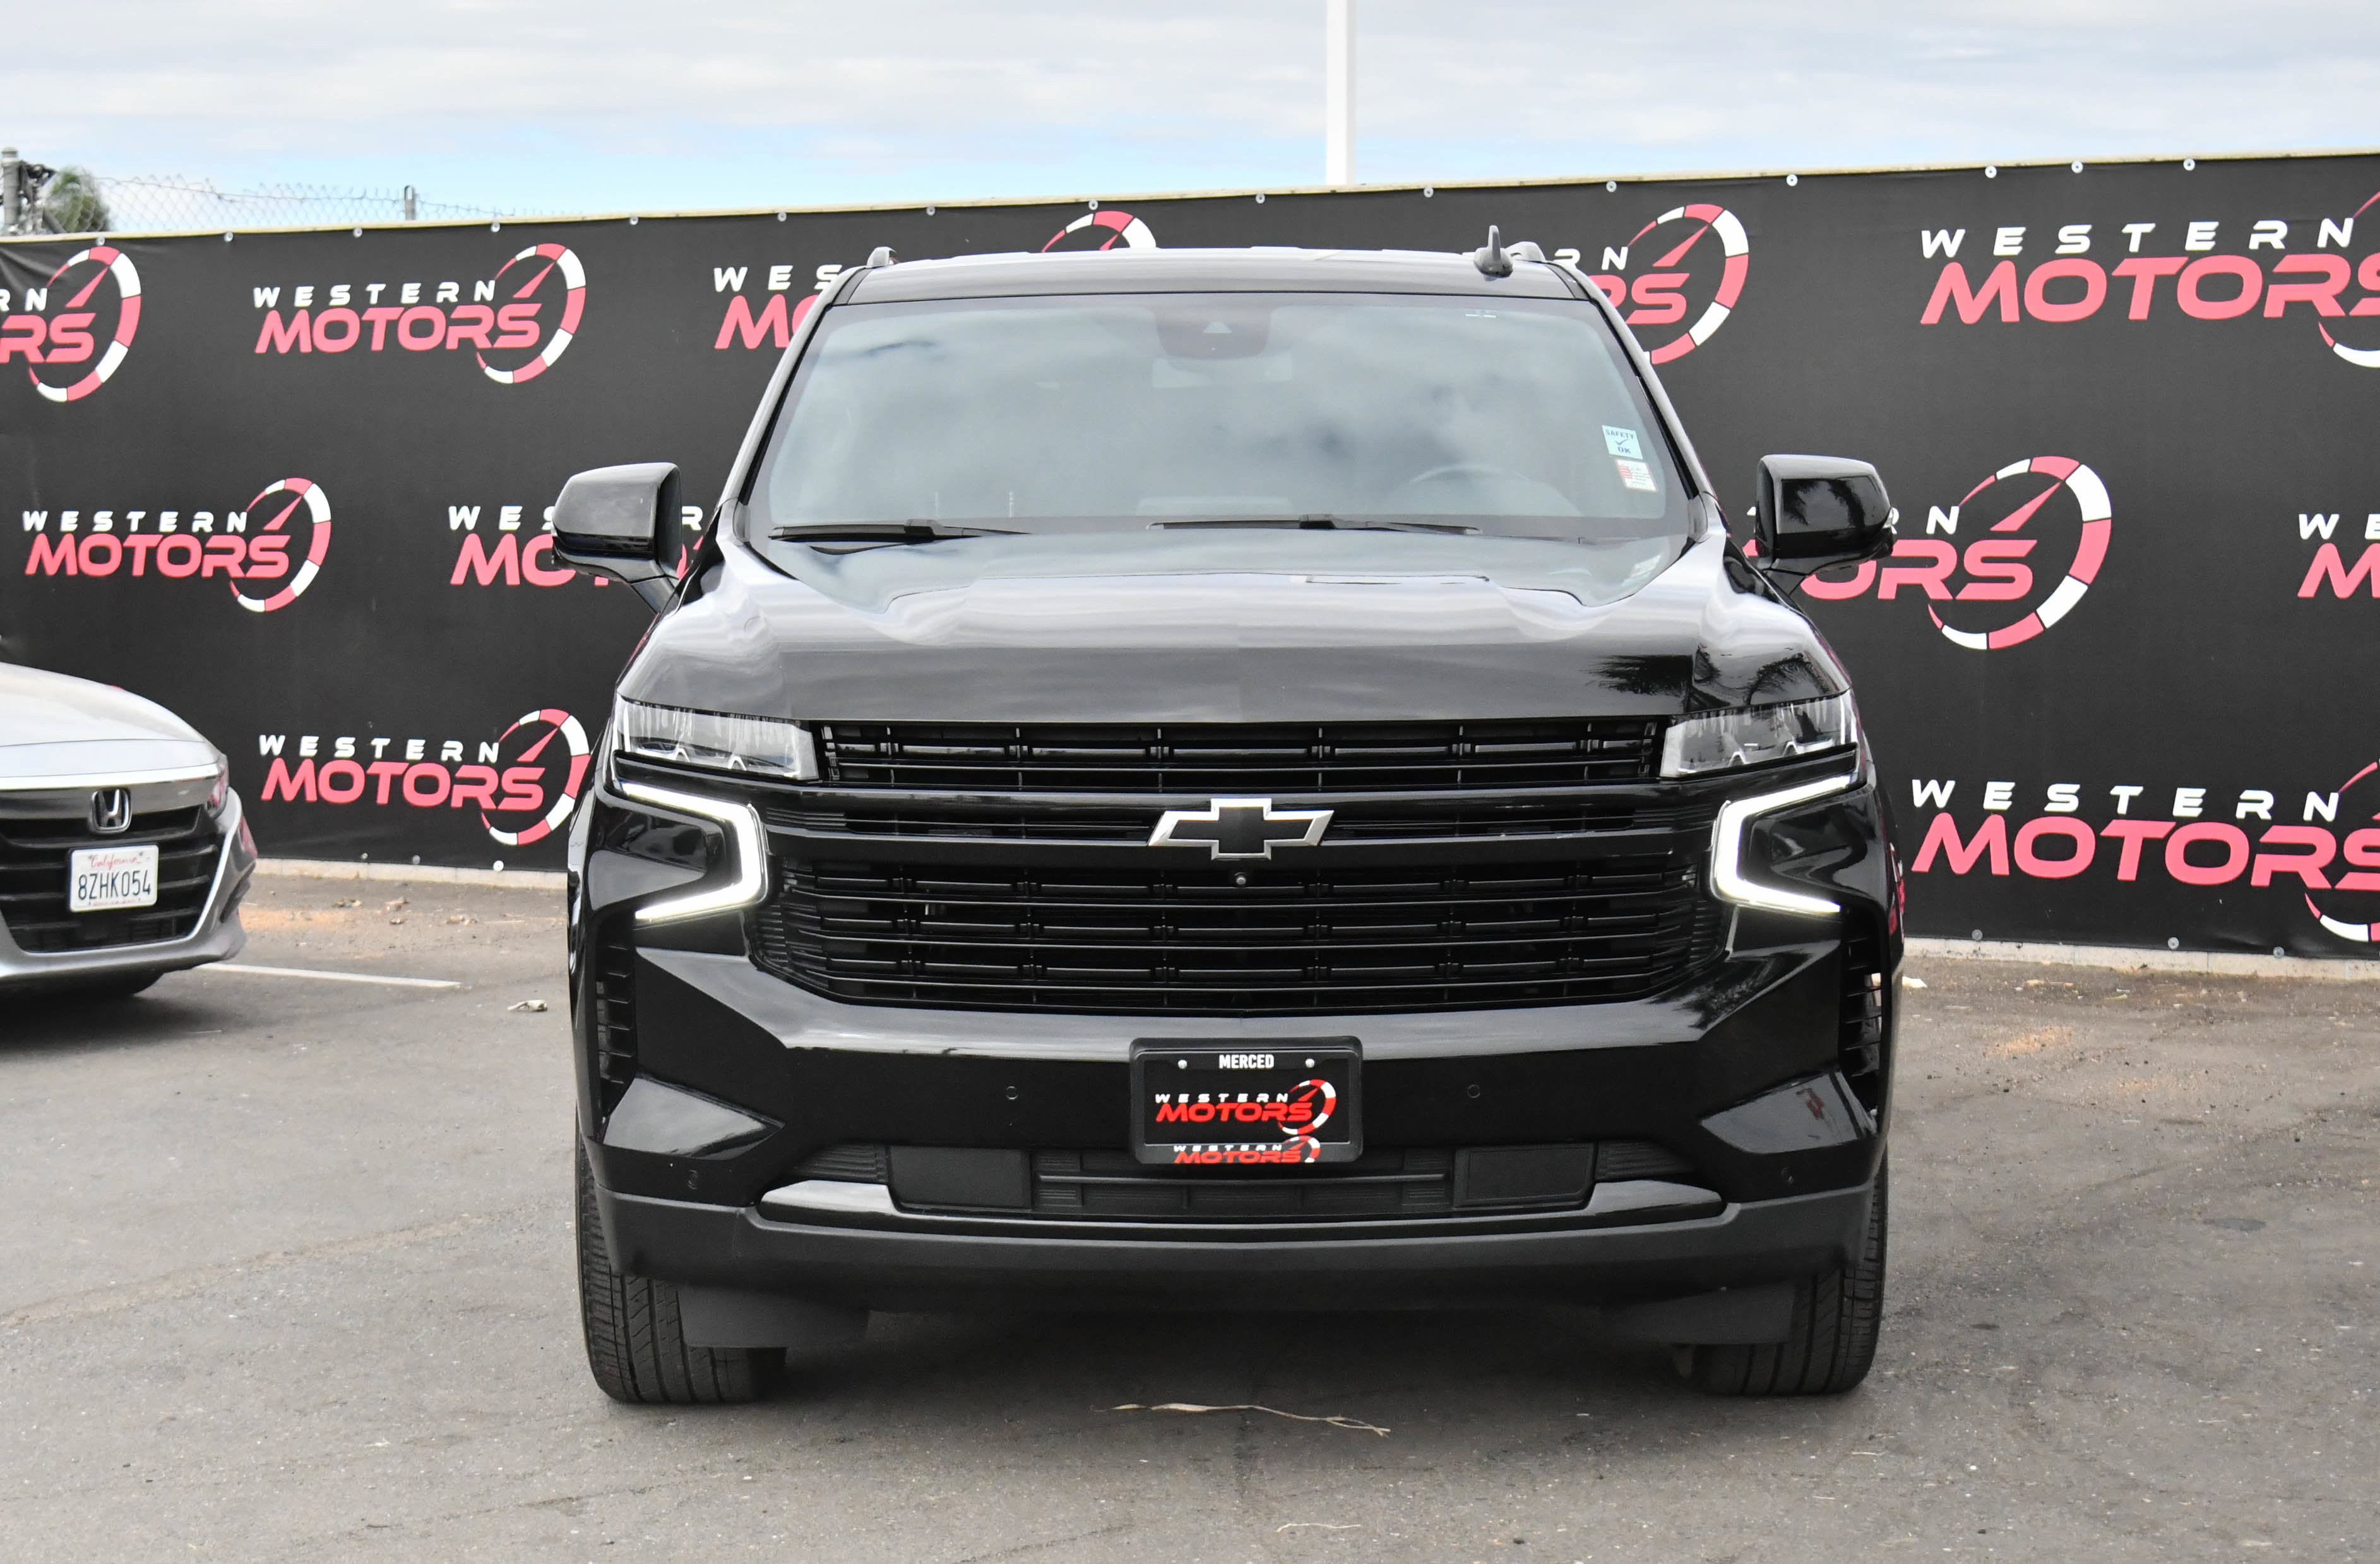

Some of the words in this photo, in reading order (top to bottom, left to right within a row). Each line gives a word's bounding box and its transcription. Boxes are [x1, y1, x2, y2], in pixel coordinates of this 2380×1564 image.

[1920, 217, 2354, 259] WESTERN
[253, 280, 496, 308] WESTERN
[255, 303, 542, 354] MOTORS
[1605, 429, 1634, 439] SAFETY
[23, 511, 247, 532] WESTERN
[25, 533, 290, 578] MOTORS
[259, 734, 499, 763] WESTERN
[261, 758, 545, 811] MOTORS
[1912, 779, 2339, 821] WESTERN
[78, 869, 151, 900] 8ZHK054
[1218, 1054, 1275, 1069] MERCED
[1155, 1093, 1288, 1104] WESTERN
[1155, 1102, 1312, 1122] MOTORS
[1173, 1144, 1282, 1152] WESTERN
[1174, 1150, 1302, 1164] MOTORS
